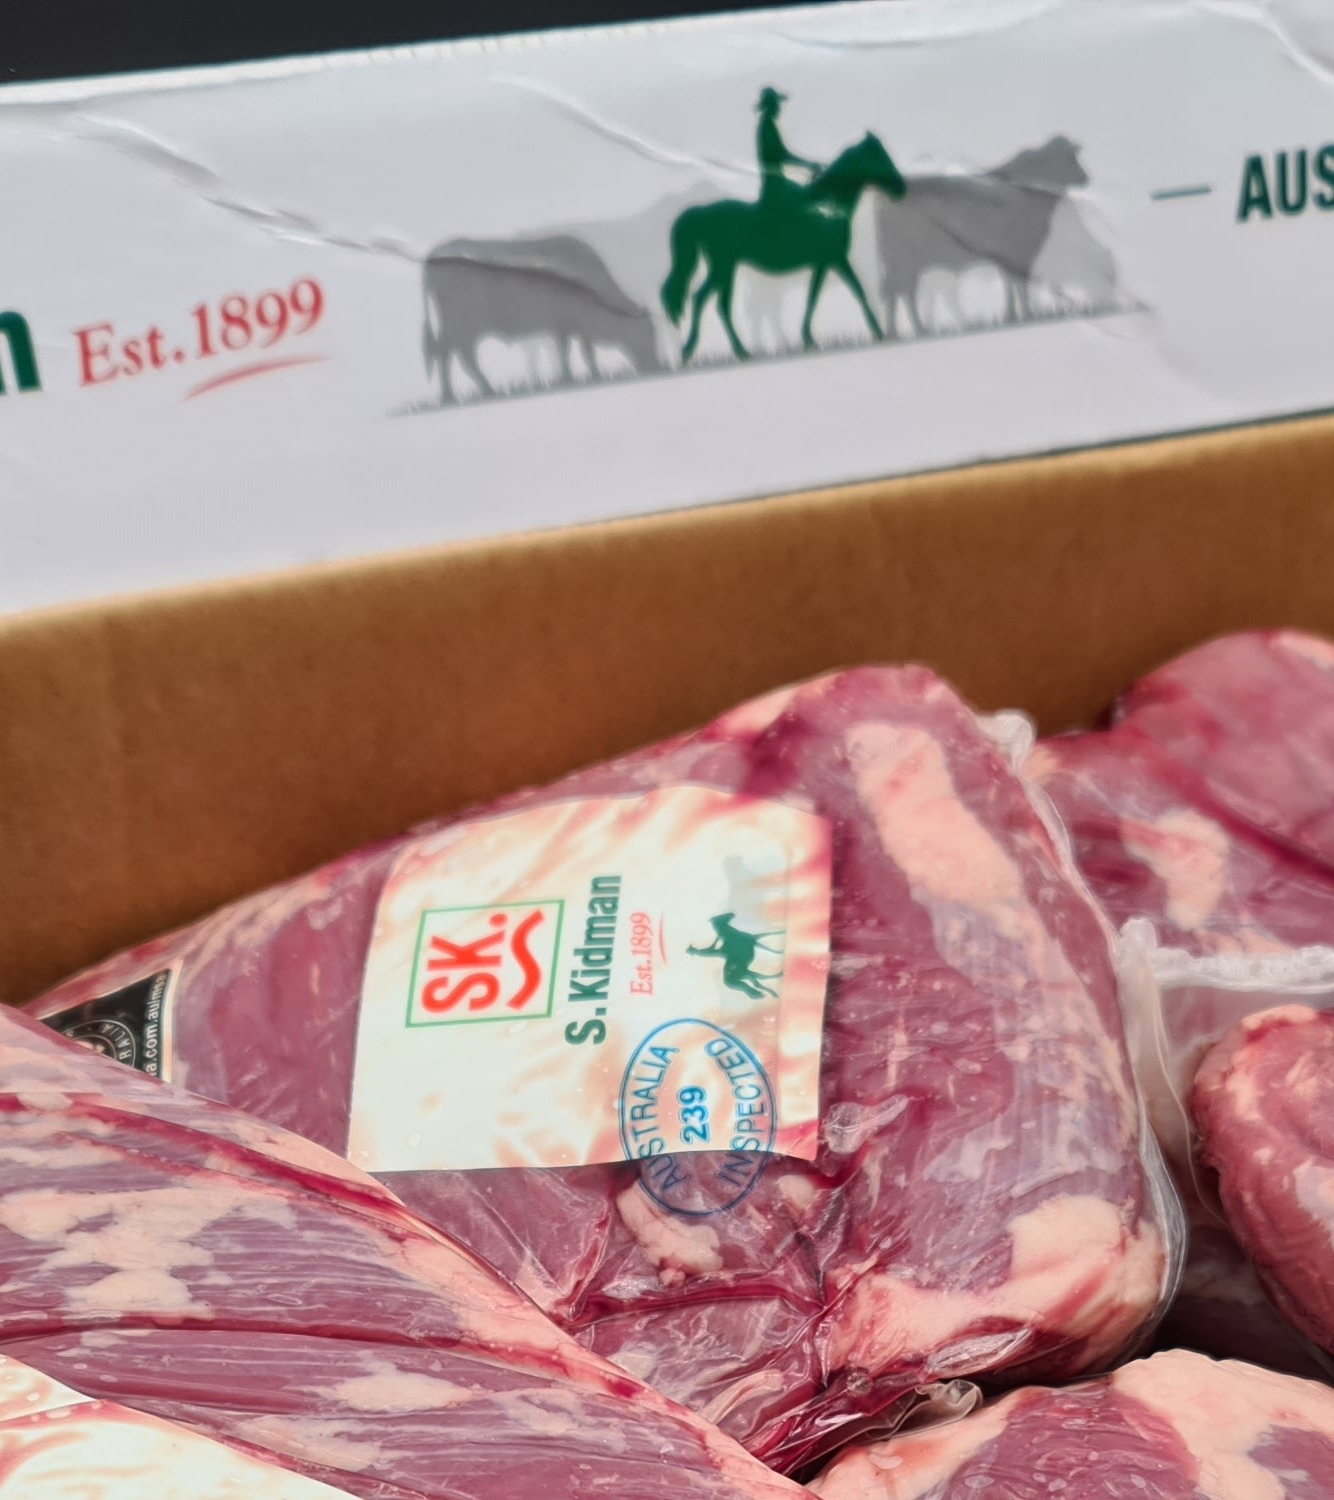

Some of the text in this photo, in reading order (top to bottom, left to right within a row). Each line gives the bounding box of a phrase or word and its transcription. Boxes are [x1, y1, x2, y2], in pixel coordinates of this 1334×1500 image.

[567, 874, 622, 1003] Kidman
[630, 1045, 692, 1192] AUSTRALIA
[679, 1086, 710, 1144] 239
[704, 1037, 766, 1188] INSPECTED
